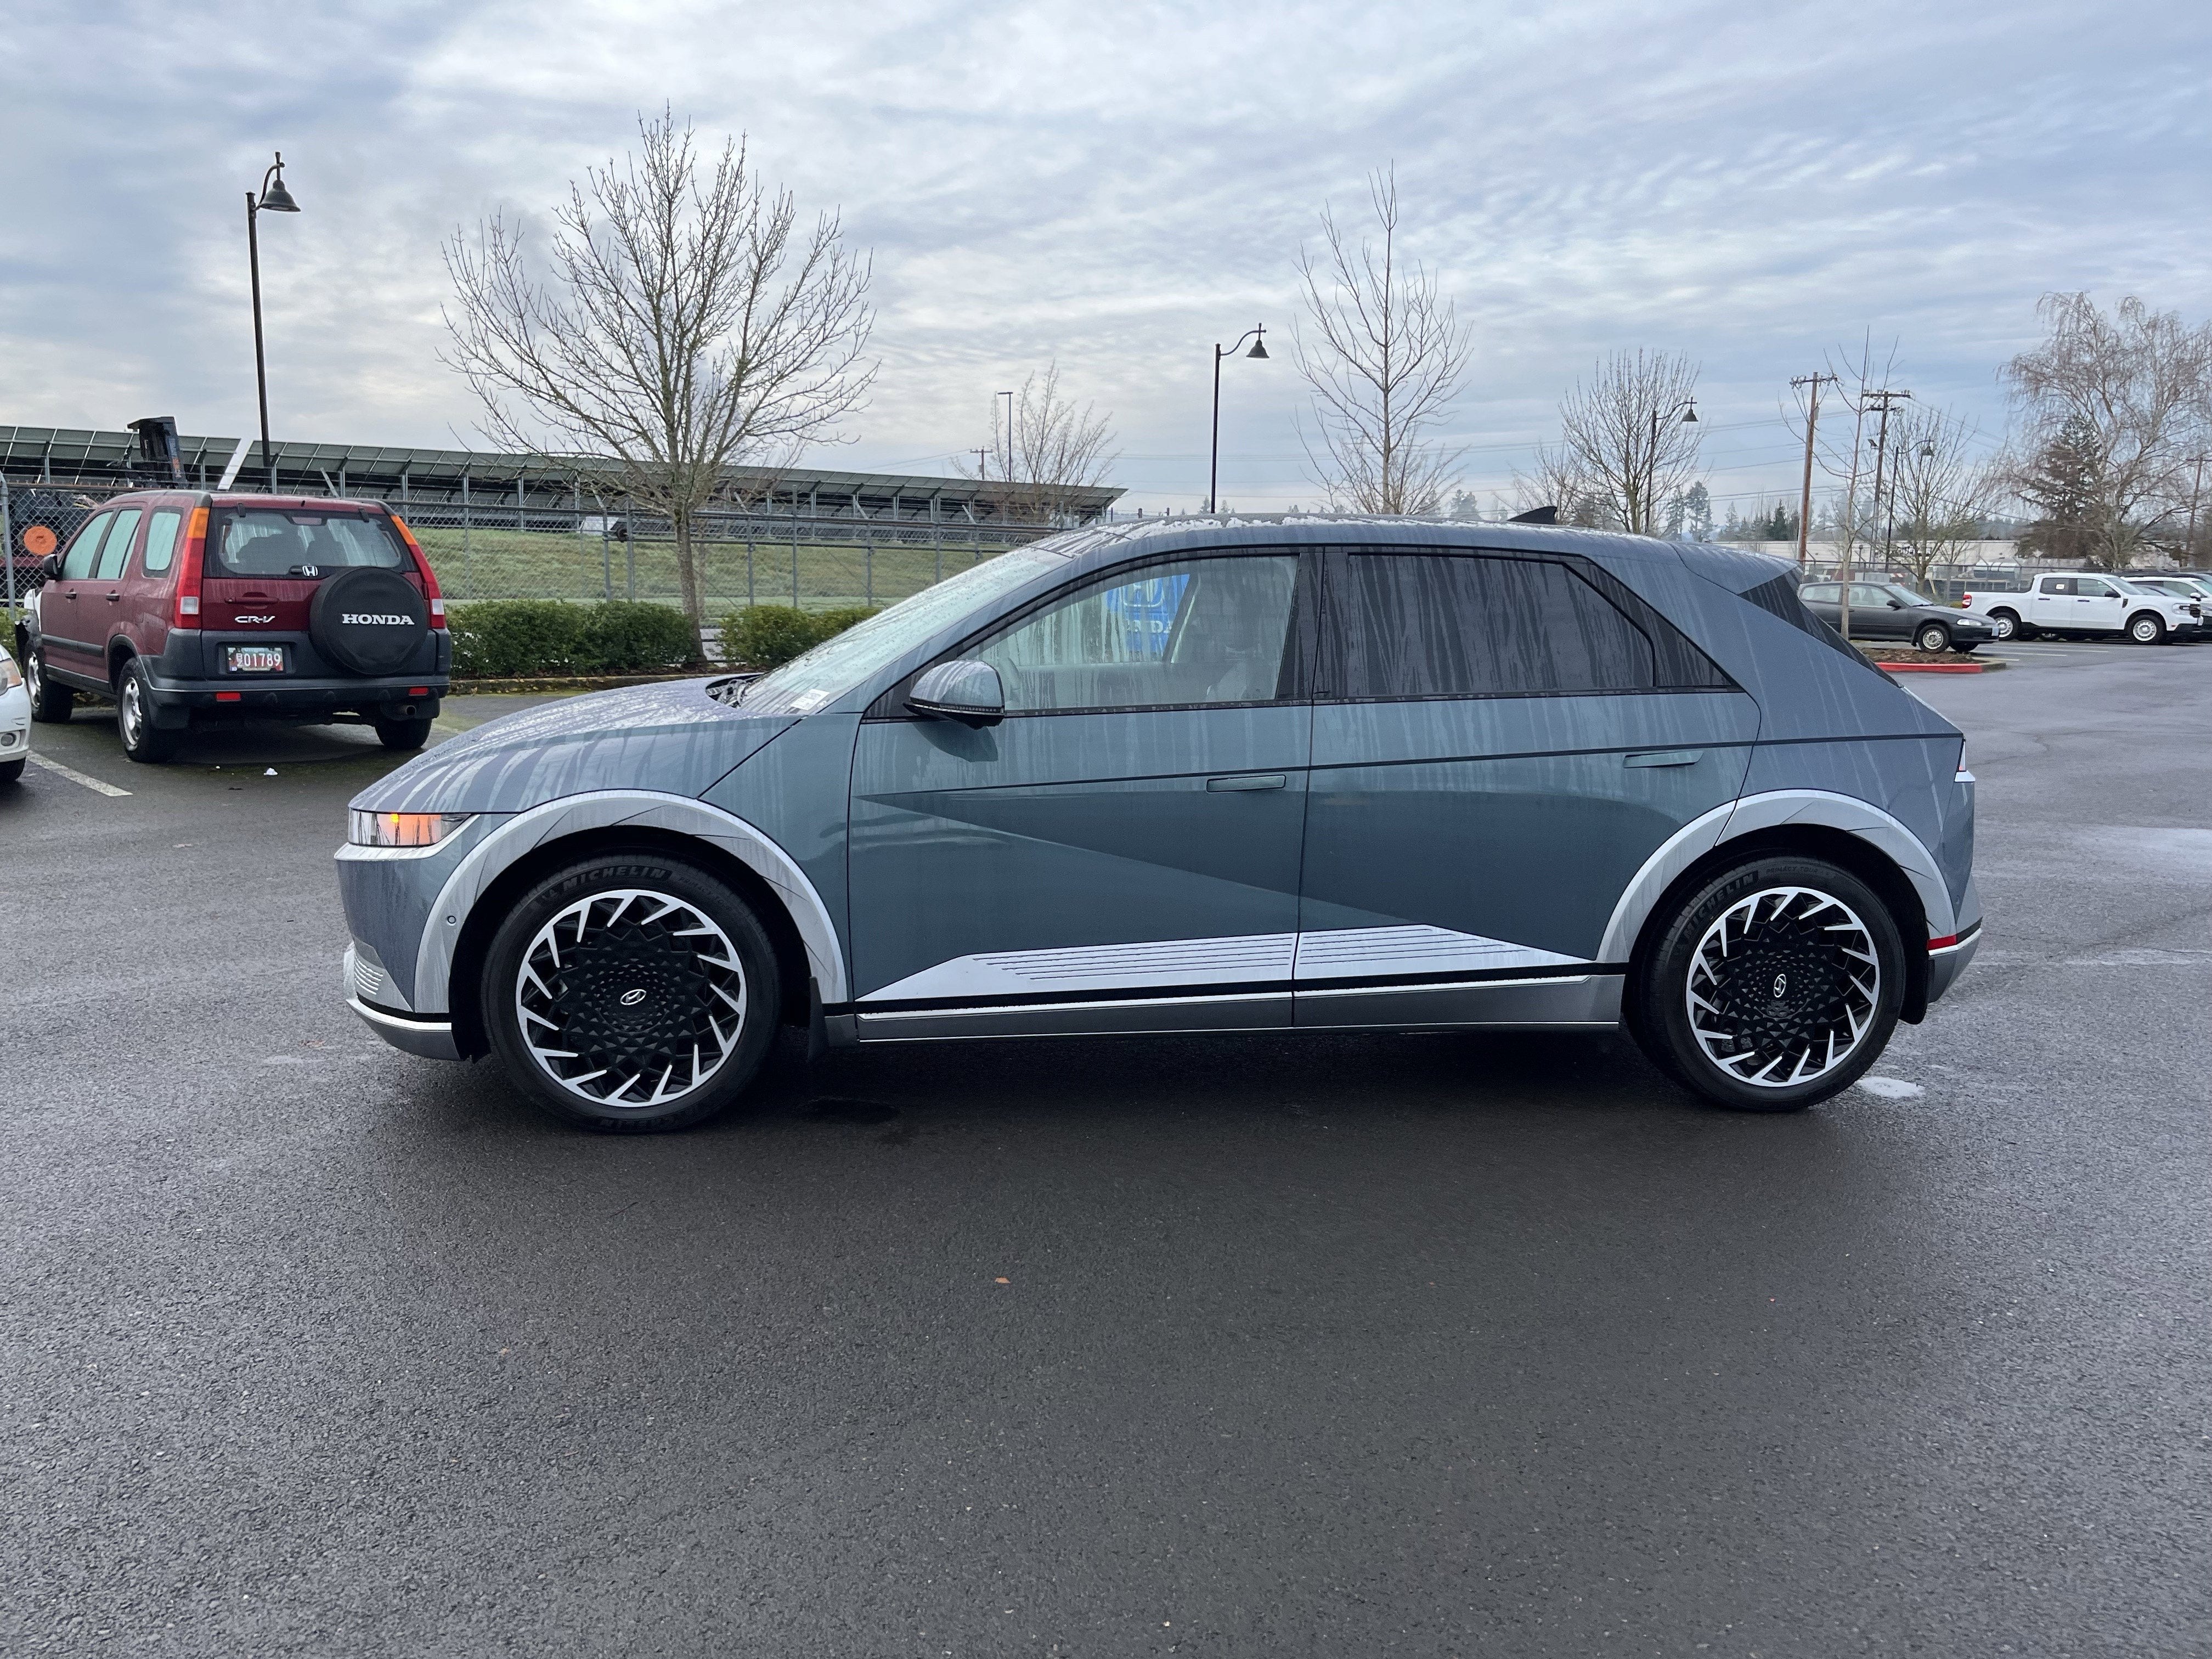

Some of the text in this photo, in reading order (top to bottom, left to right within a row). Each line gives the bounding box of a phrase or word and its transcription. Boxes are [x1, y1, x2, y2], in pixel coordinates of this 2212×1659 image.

[342, 614, 415, 625] HONDA
[563, 865, 667, 890] MICHELIN
[1684, 872, 1754, 939] MICHELIN
